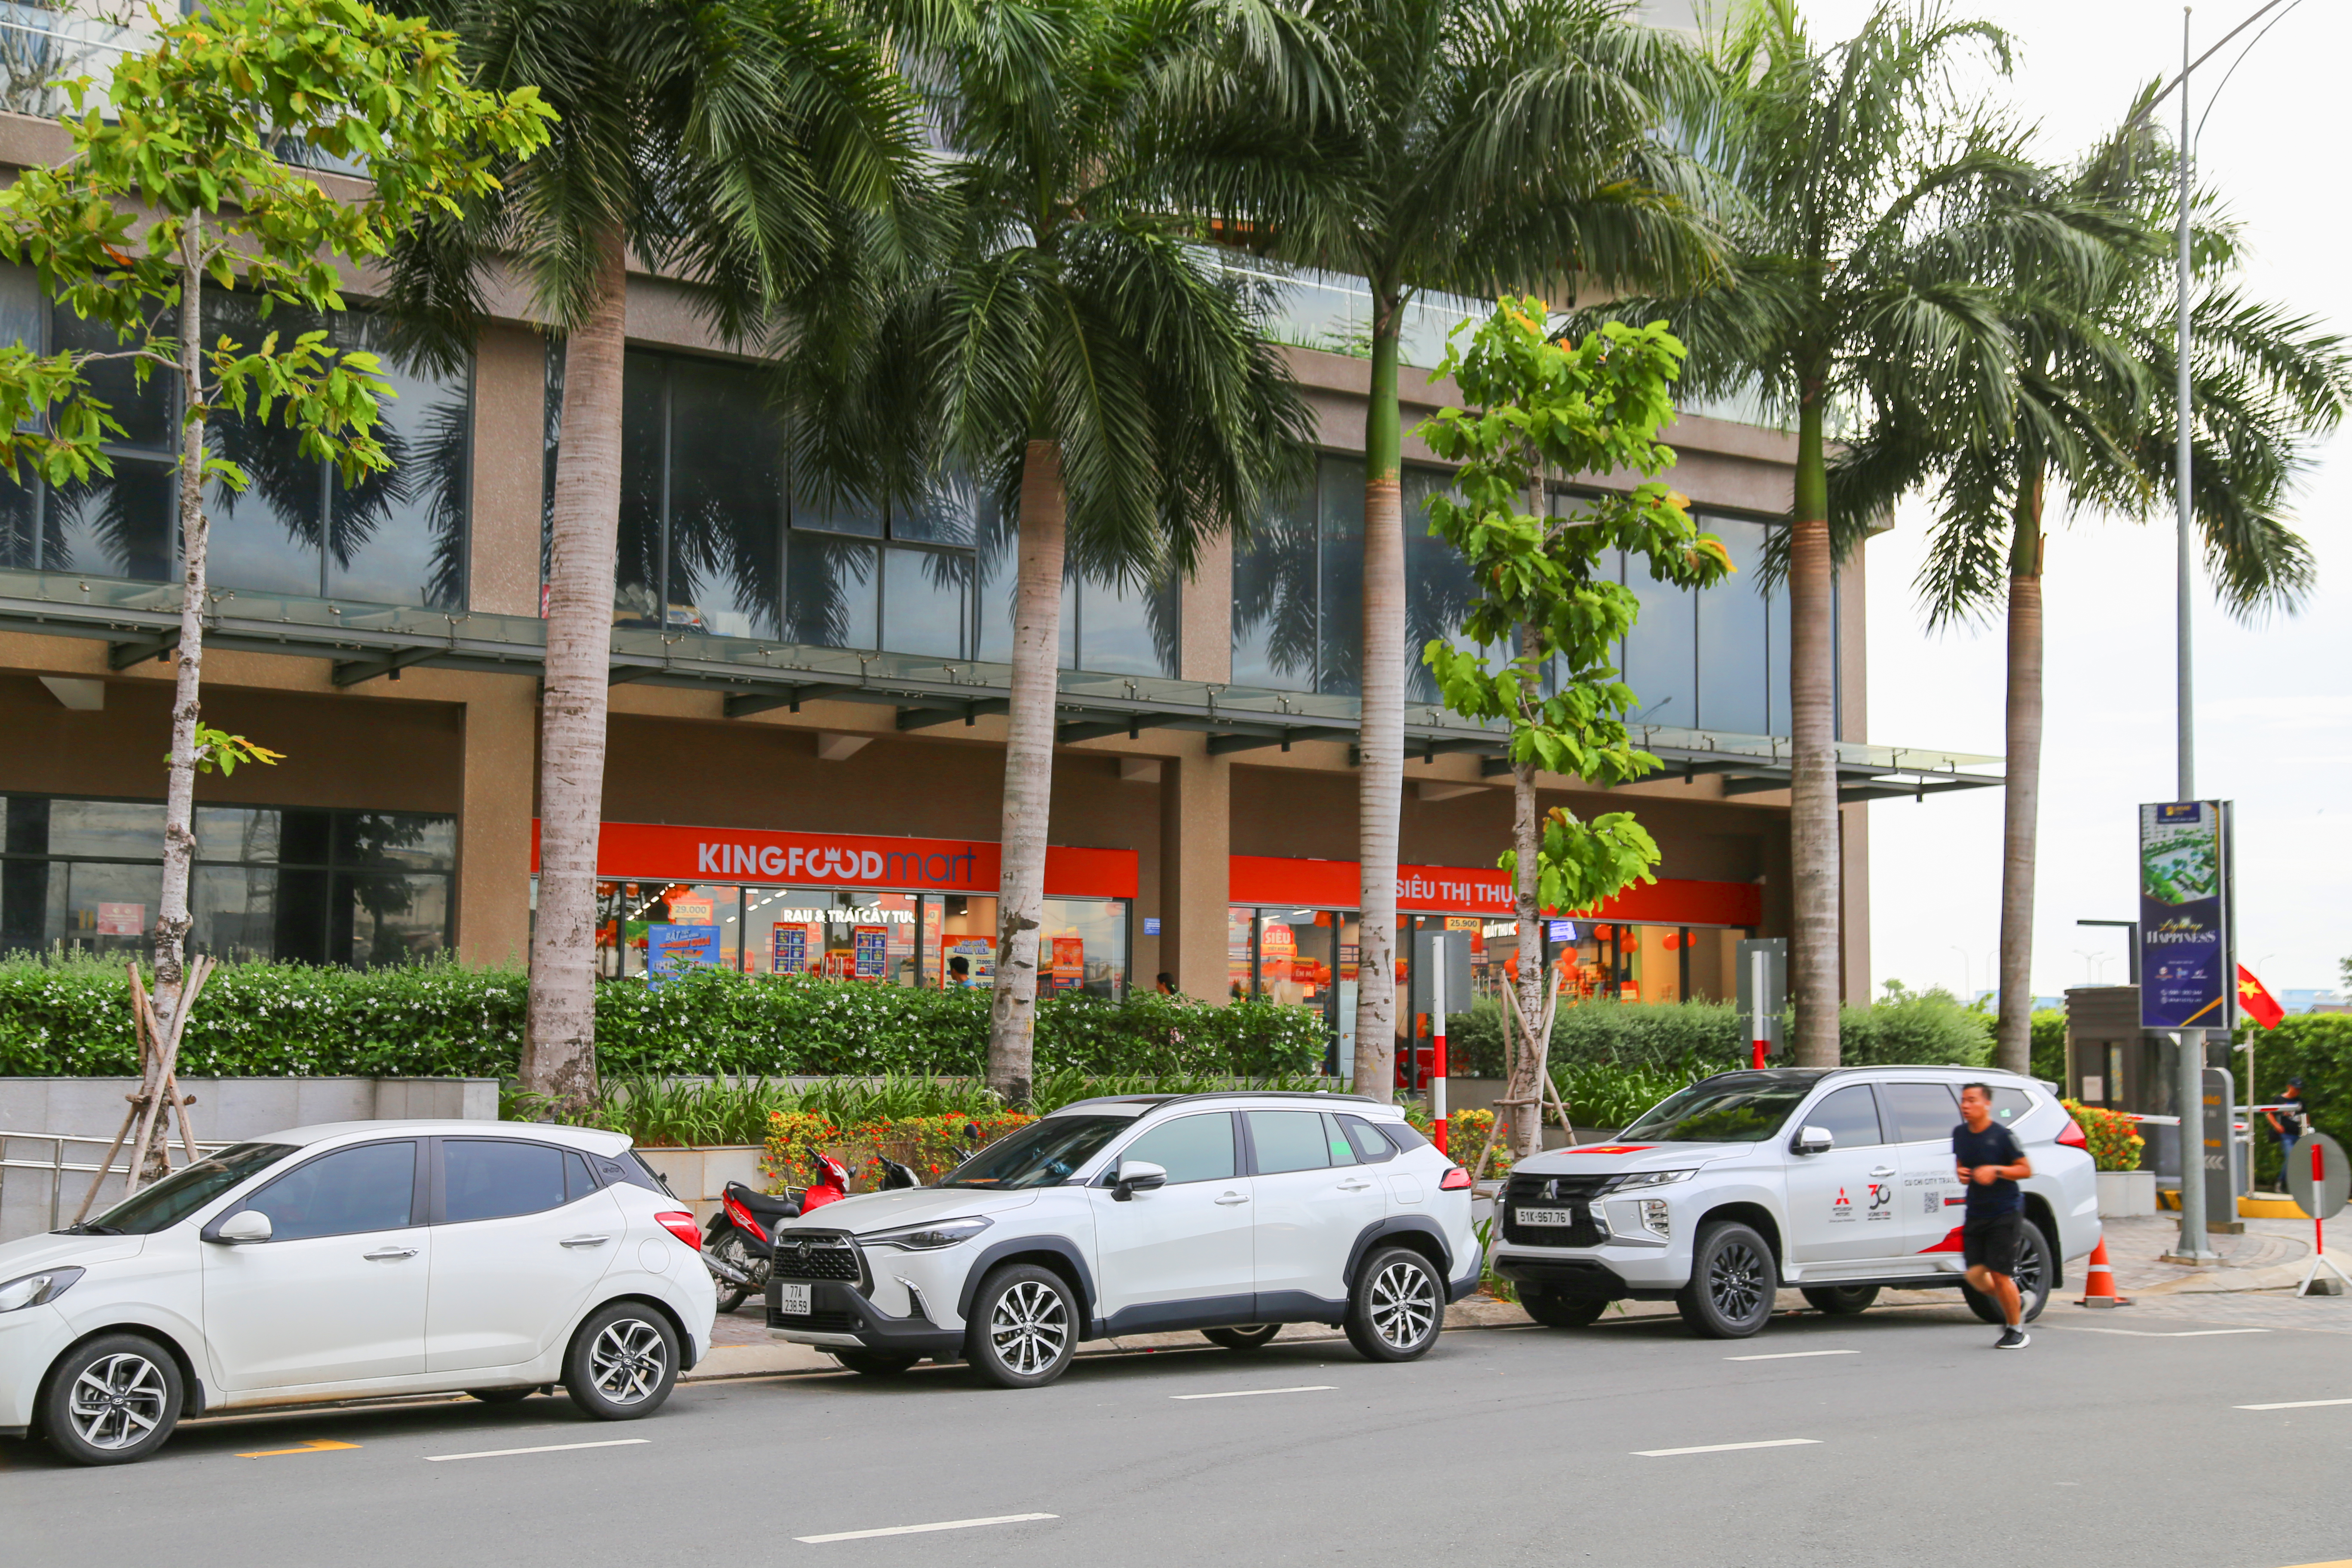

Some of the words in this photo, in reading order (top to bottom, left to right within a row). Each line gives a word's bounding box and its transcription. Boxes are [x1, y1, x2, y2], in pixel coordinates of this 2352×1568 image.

[1396, 874, 1435, 899] SIÊU
[1439, 882, 1470, 906] THỊ
[783, 909, 813, 923] RAU
[814, 909, 827, 924] &
[827, 906, 860, 923] TRÁI
[861, 907, 891, 923] CÂY
[1265, 929, 1291, 944] SIÊU
[2147, 930, 2216, 943] HAPPINESS
[1521, 1211, 1566, 1223] 51K-967.76
[790, 1286, 802, 1298] 77A
[785, 1300, 807, 1313] 238.59
